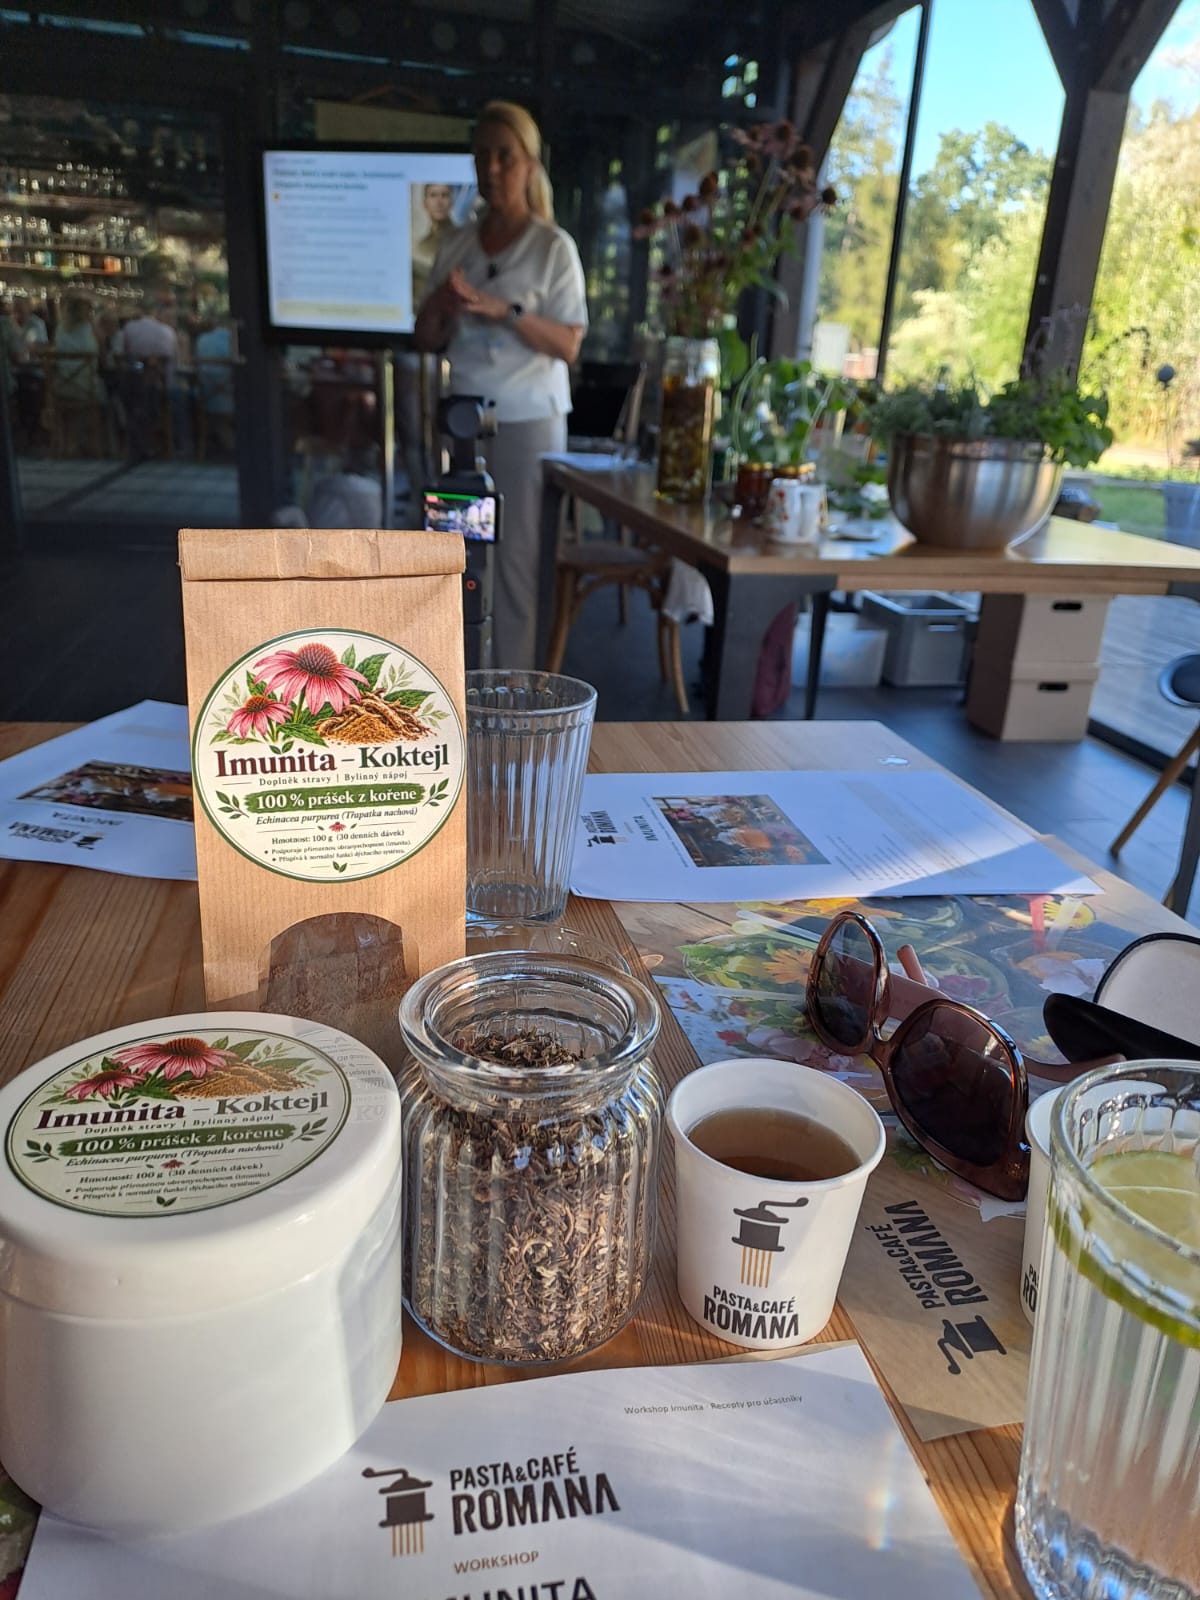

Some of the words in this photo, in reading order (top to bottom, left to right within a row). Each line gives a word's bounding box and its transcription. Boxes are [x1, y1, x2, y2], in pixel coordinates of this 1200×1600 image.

[214, 748, 337, 777] Imunita
[358, 744, 449, 771] Koktejl
[259, 777, 298, 786] Doplněk
[302, 775, 331, 784] stravy
[344, 772, 379, 782] Bylinný
[382, 770, 408, 780] nápoj
[257, 794, 287, 809] 100
[290, 793, 305, 807] %
[308, 789, 355, 808] prášek
[358, 793, 367, 803] z
[369, 788, 417, 802] kořene
[256, 815, 299, 825] Echinacea
[301, 813, 339, 824] purpurea
[32, 1102, 186, 1130] Imunita
[214, 1091, 328, 1115] Koktejl
[84, 1125, 134, 1136] Doplněk
[138, 1122, 177, 1131] stravy
[192, 1116, 238, 1127] Bylinný
[242, 1114, 274, 1123] nápoj
[74, 1138, 114, 1153] 100
[118, 1137, 136, 1150] %
[140, 1133, 200, 1151] prášek
[207, 1135, 217, 1143] z
[222, 1127, 284, 1142] kořene
[65, 1156, 124, 1167] Echinacea
[125, 1153, 178, 1164] purpurea
[136, 1171, 155, 1180] 100
[865, 1223, 946, 1309] PASTA&CAFÉ
[884, 1200, 989, 1306] ROMANA
[713, 1284, 796, 1314] PASTA&CAFÉ
[703, 1294, 799, 1339] ROMANA
[624, 1404, 669, 1415] Workshop
[671, 1403, 704, 1412] Imunita
[710, 1401, 745, 1411] Recepty
[746, 1400, 761, 1409] pro
[763, 1394, 803, 1406] účastníky
[450, 1446, 580, 1491] PASTA&CAFÉ
[451, 1472, 621, 1535] ROMANA
[454, 1551, 540, 1574] WORKSHOP
